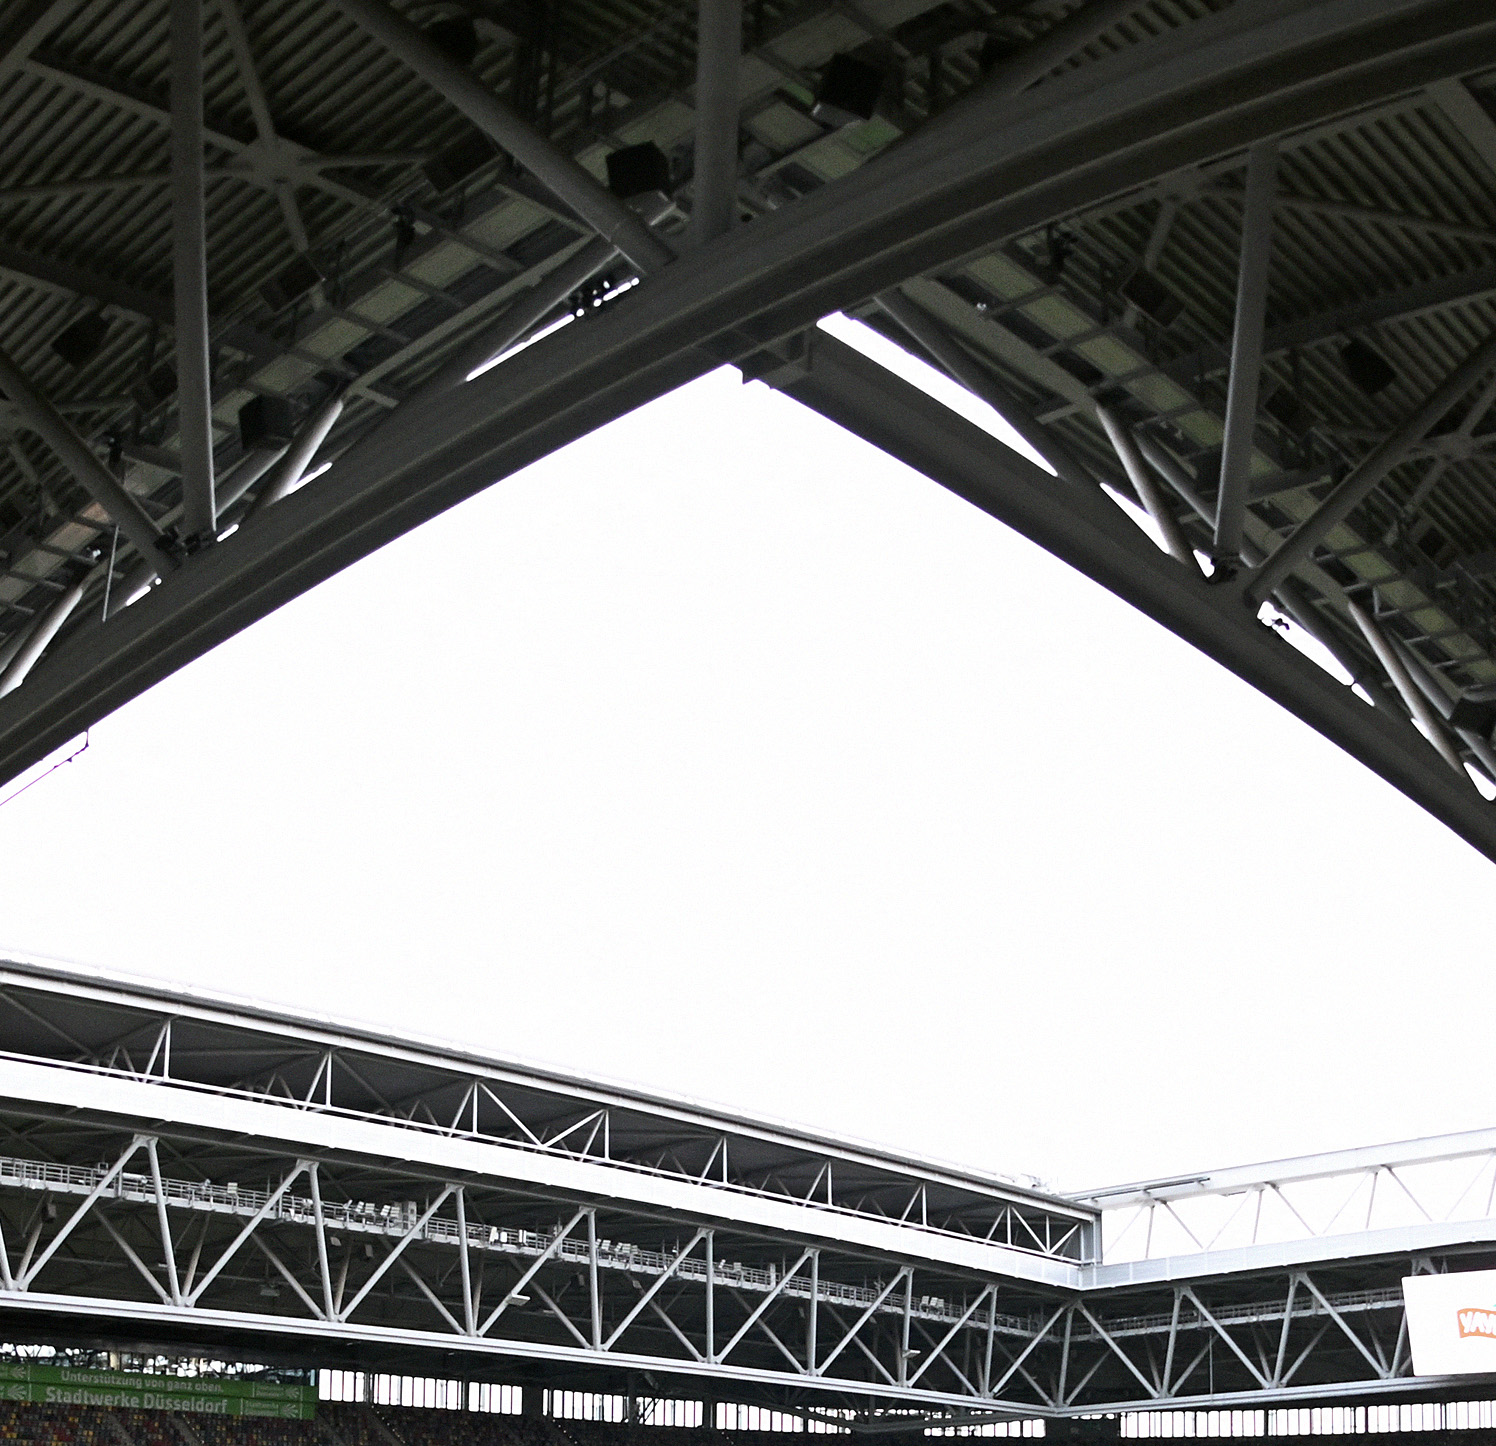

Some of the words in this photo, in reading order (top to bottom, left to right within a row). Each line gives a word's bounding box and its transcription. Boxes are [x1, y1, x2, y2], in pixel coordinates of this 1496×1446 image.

[61, 1370, 142, 1389] Unterstützung
[145, 1377, 165, 1388] von
[167, 1379, 192, 1393] ganz
[195, 1381, 224, 1393] oben.
[45, 1387, 140, 1408] Stadtwerke
[143, 1392, 228, 1414] Düsseldorf
